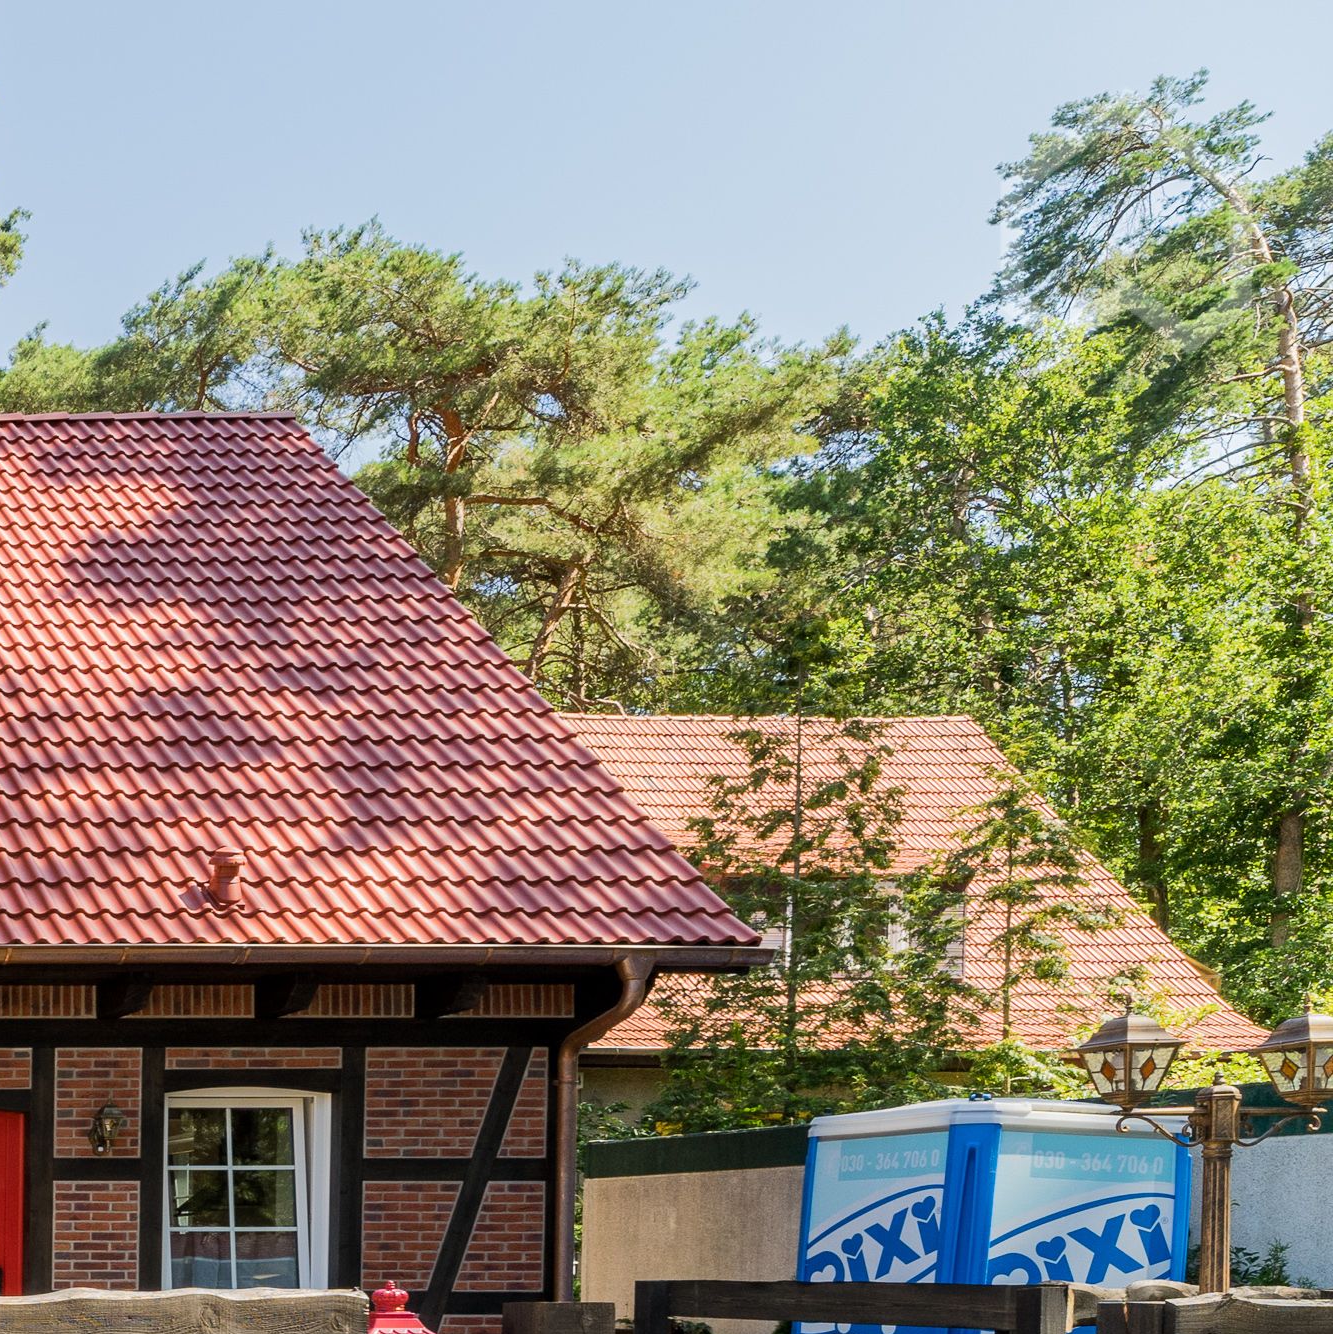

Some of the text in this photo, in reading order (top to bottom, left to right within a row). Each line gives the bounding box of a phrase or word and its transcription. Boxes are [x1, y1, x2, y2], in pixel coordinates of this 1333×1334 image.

[840, 1154, 864, 1172] 030
[875, 1153, 899, 1170] 364
[902, 1150, 927, 1168] 706
[930, 1149, 940, 1167] 0
[1033, 1150, 1065, 1169] 030
[1081, 1152, 1112, 1172] 364
[1118, 1155, 1148, 1174] 706
[1152, 1156, 1164, 1175] 0
